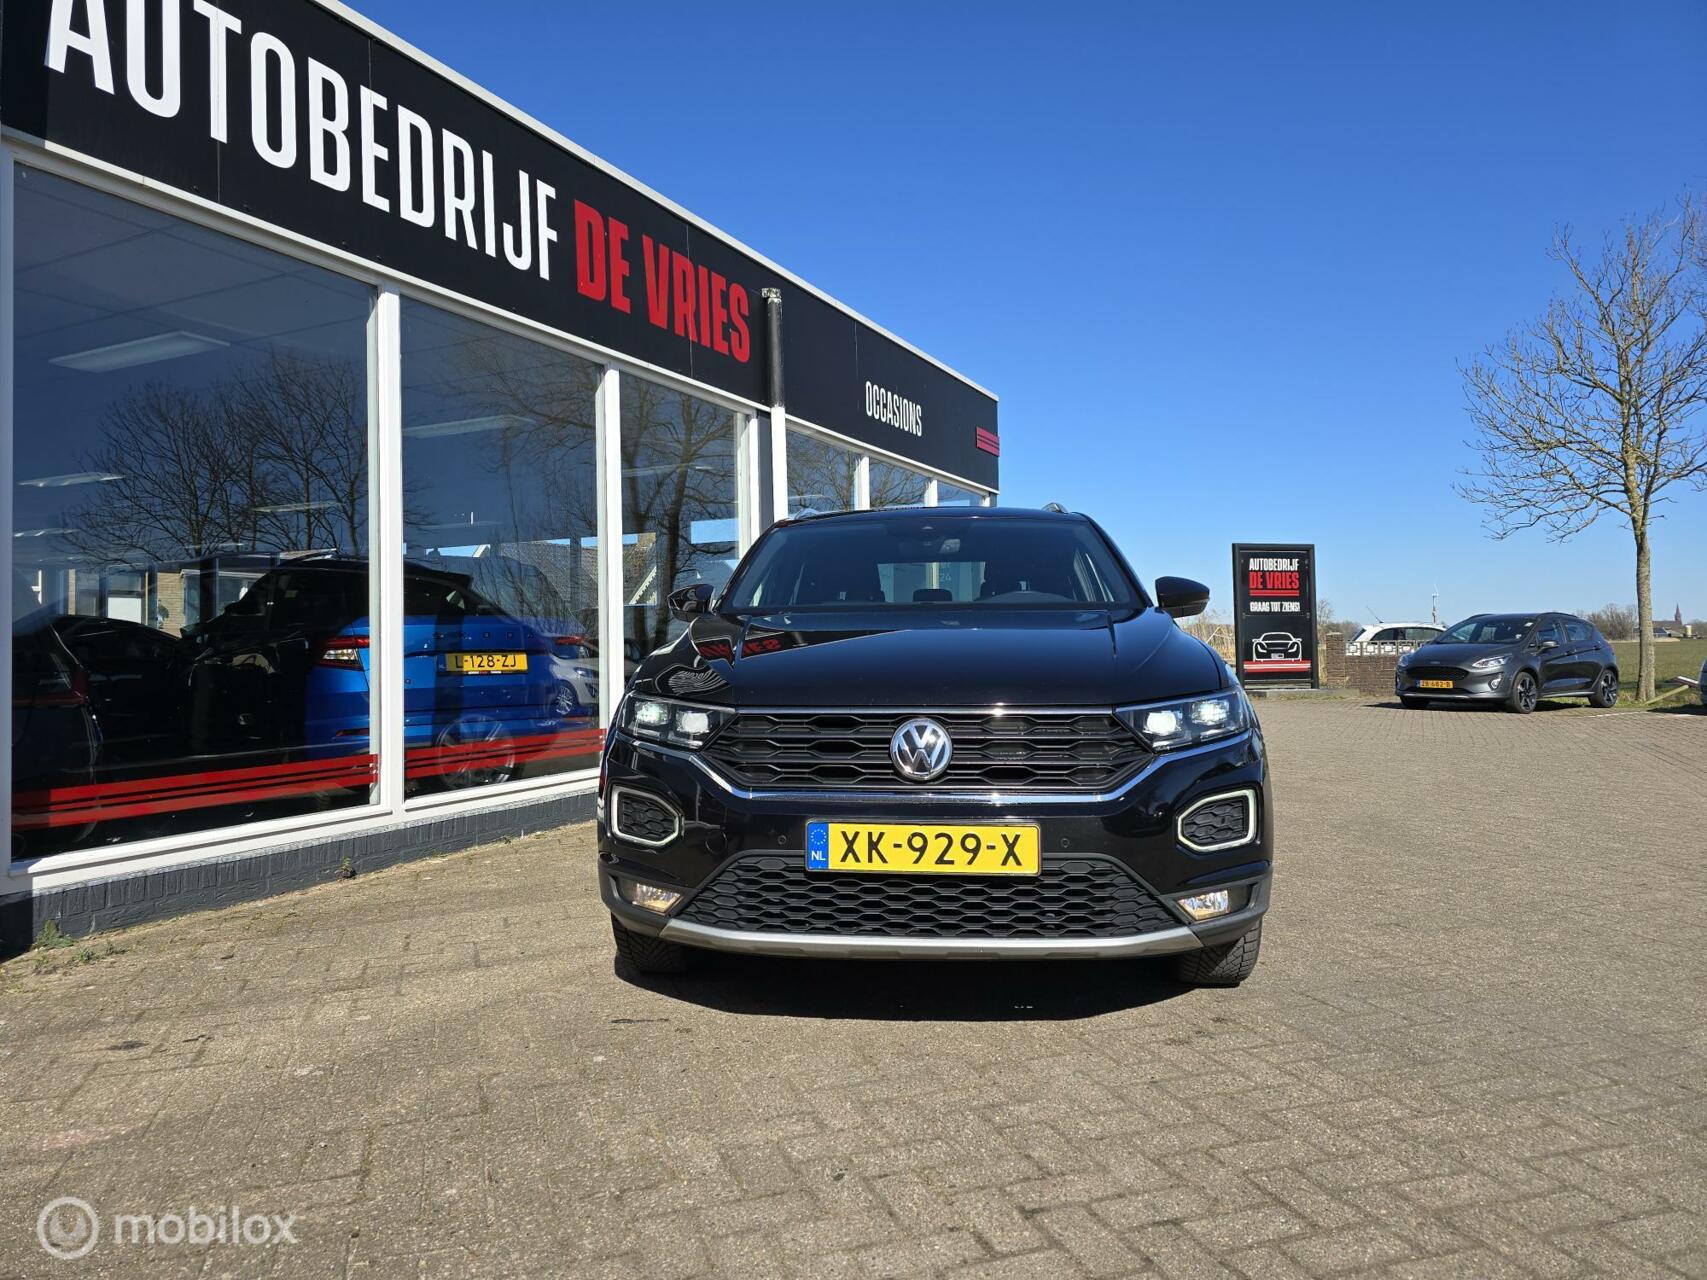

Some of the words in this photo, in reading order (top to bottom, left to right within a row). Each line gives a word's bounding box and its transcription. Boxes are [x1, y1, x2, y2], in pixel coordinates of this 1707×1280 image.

[44, 0, 557, 280] AUTOBEDRIJF
[574, 199, 631, 314] DE
[642, 234, 750, 363] VRIES
[865, 380, 923, 438] OCCASIONS
[1248, 558, 1300, 571] AUTOBEDRIJF
[1249, 572, 1264, 589] DE
[1265, 572, 1300, 589] VRIES
[1250, 601, 1270, 612] GRAAG
[1270, 601, 1281, 612] TOT
[455, 654, 518, 669] L-128-ZJ
[840, 830, 1023, 867] XK-929-X
[811, 852, 826, 862] NL
